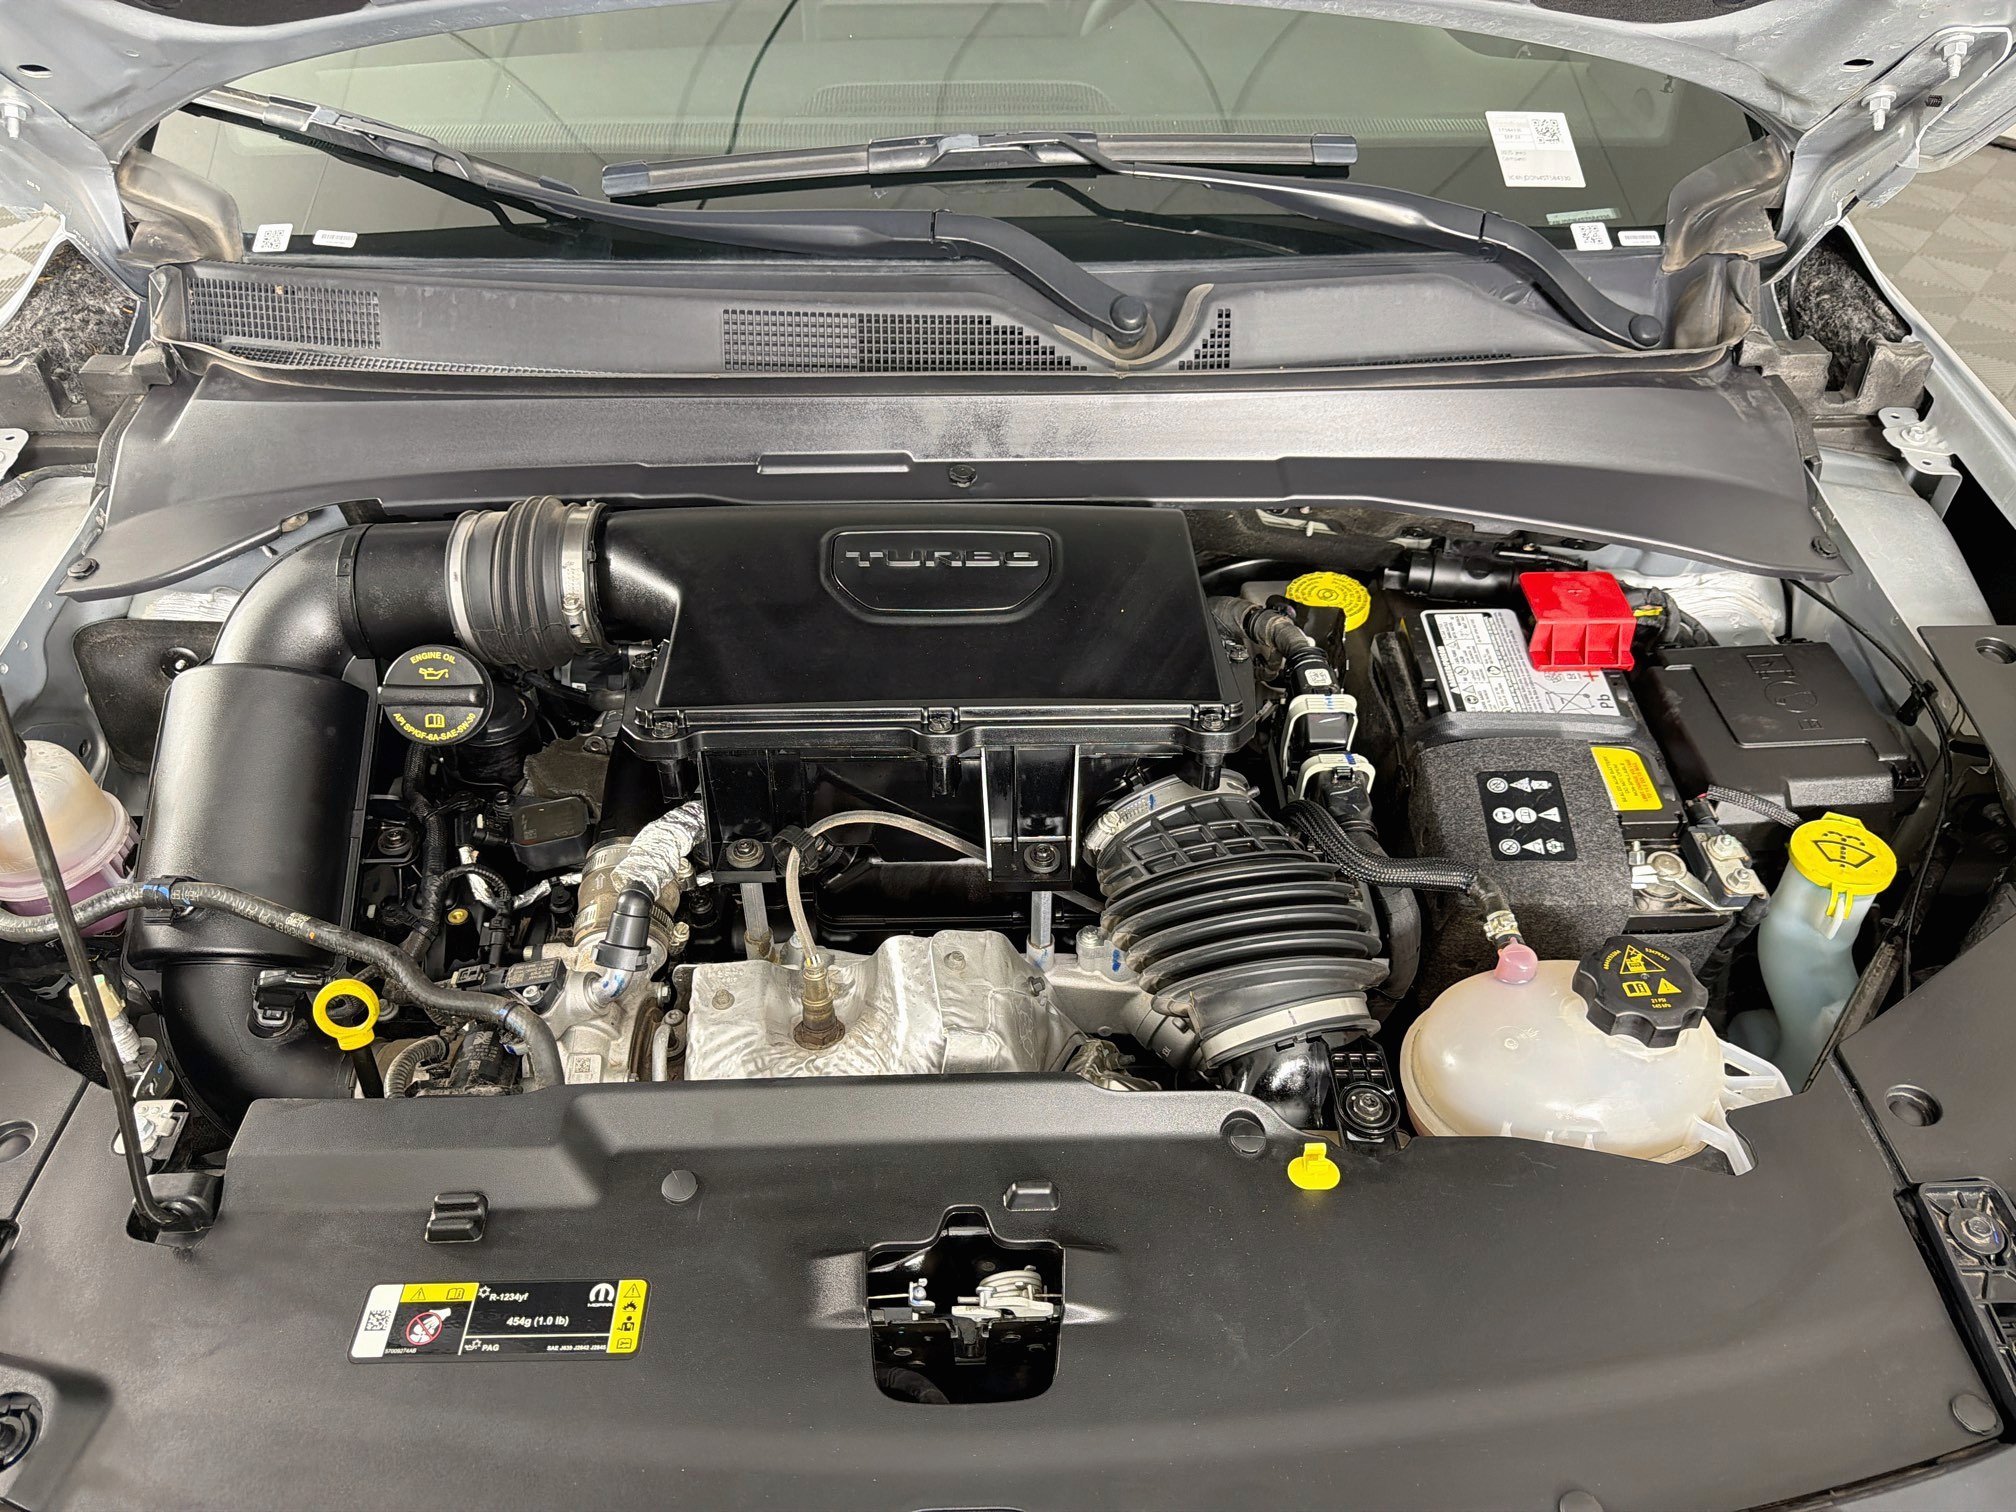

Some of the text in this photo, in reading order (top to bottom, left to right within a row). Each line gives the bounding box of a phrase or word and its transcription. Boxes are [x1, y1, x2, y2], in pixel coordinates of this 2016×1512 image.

[845, 549, 1040, 568] TURBO
[409, 651, 456, 665] ENGINE OIL
[1597, 693, 1614, 709] Pb
[393, 712, 407, 727] API
[489, 1292, 529, 1303] R-1234yf
[506, 1315, 569, 1328] 454g (1.0 lb)
